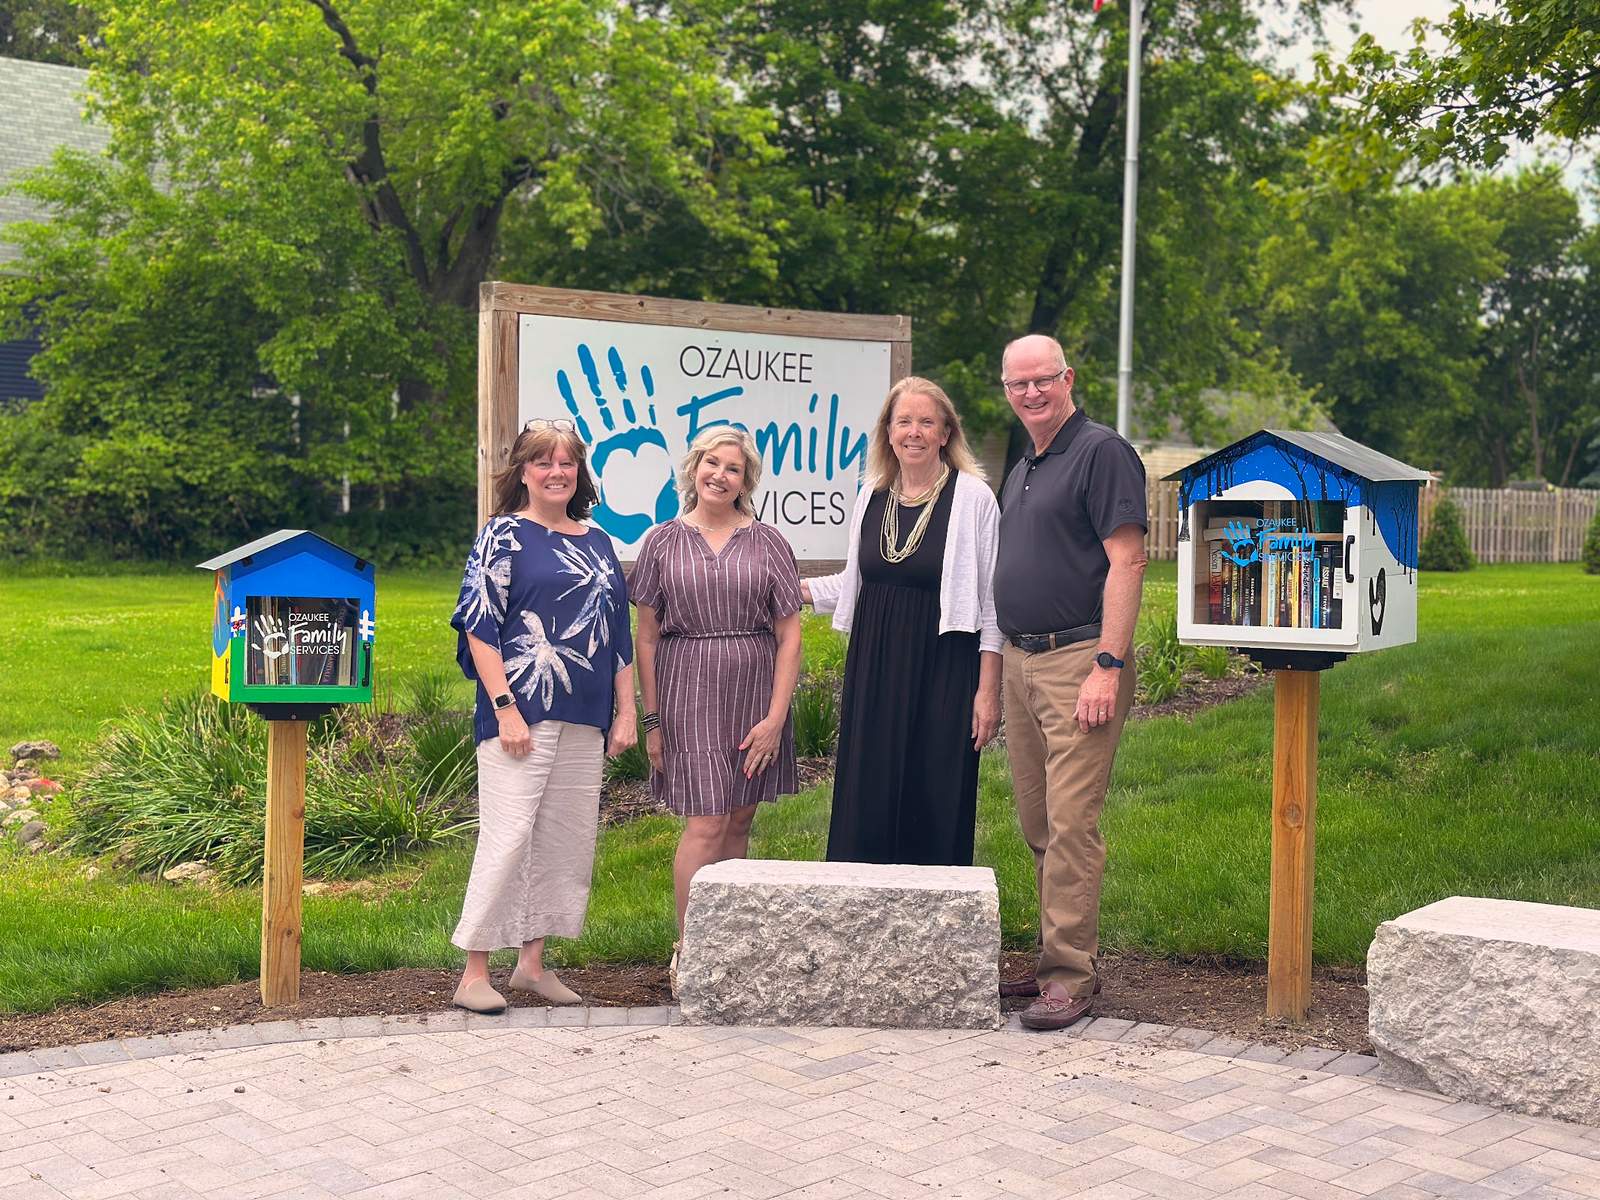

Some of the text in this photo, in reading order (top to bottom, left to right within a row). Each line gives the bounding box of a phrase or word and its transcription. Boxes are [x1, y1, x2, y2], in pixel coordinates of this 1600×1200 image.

[679, 345, 813, 384] OZAUKEE
[676, 386, 868, 496] Fmily
[752, 491, 845, 526] VICES
[1256, 517, 1297, 528] OZAUKEE
[1256, 527, 1316, 561] Family
[288, 613, 329, 622] OZAUKEE
[288, 622, 347, 655] Family
[289, 645, 340, 655] SERVICES
